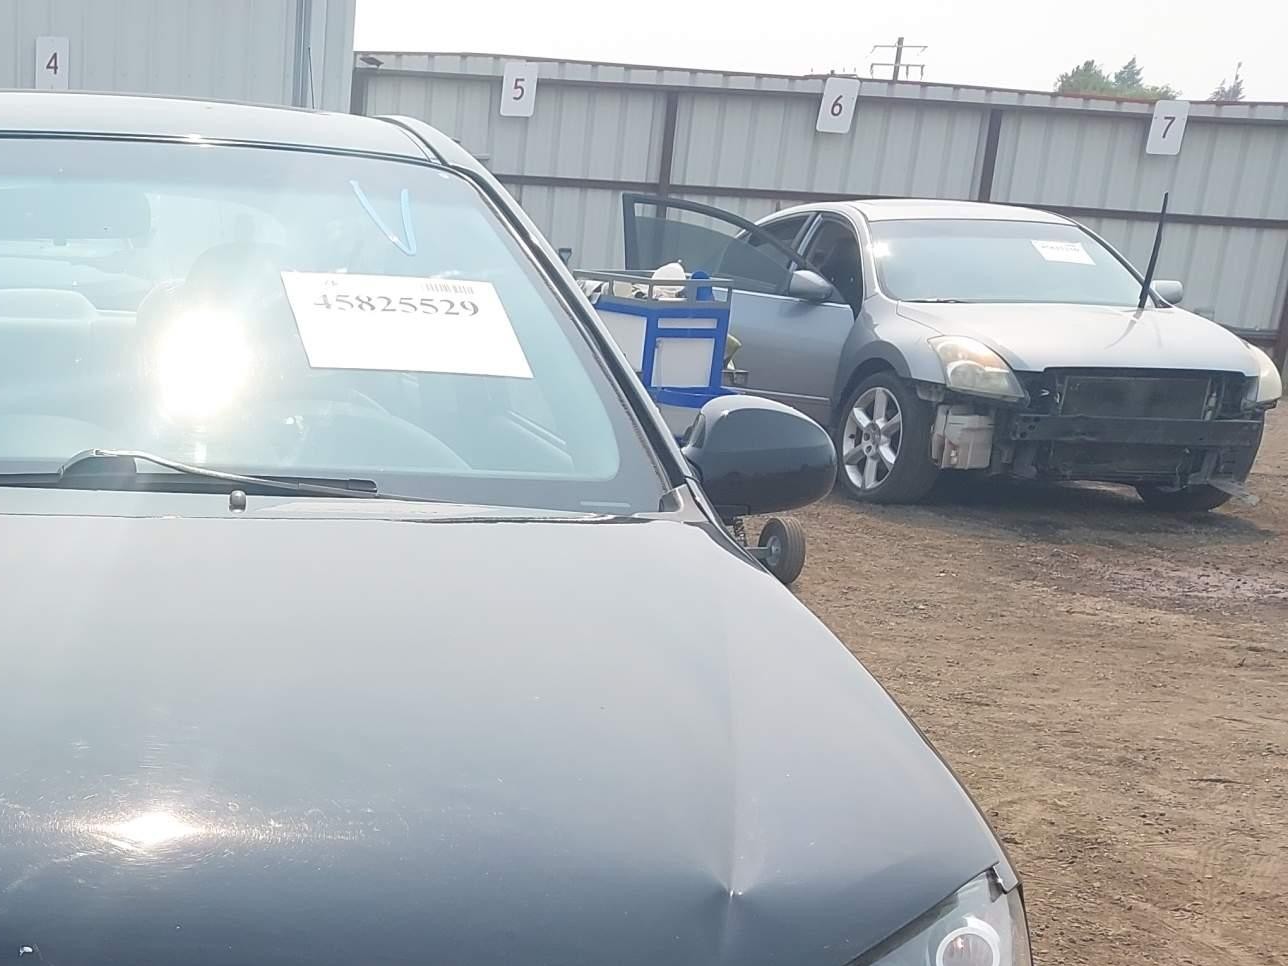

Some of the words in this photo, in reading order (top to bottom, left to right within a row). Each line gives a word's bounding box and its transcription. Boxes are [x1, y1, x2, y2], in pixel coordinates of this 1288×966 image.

[45, 52, 60, 75] 4
[512, 77, 526, 101] 5
[830, 94, 844, 117] 6
[1162, 116, 1176, 139] 7
[314, 293, 480, 317] 45825529
